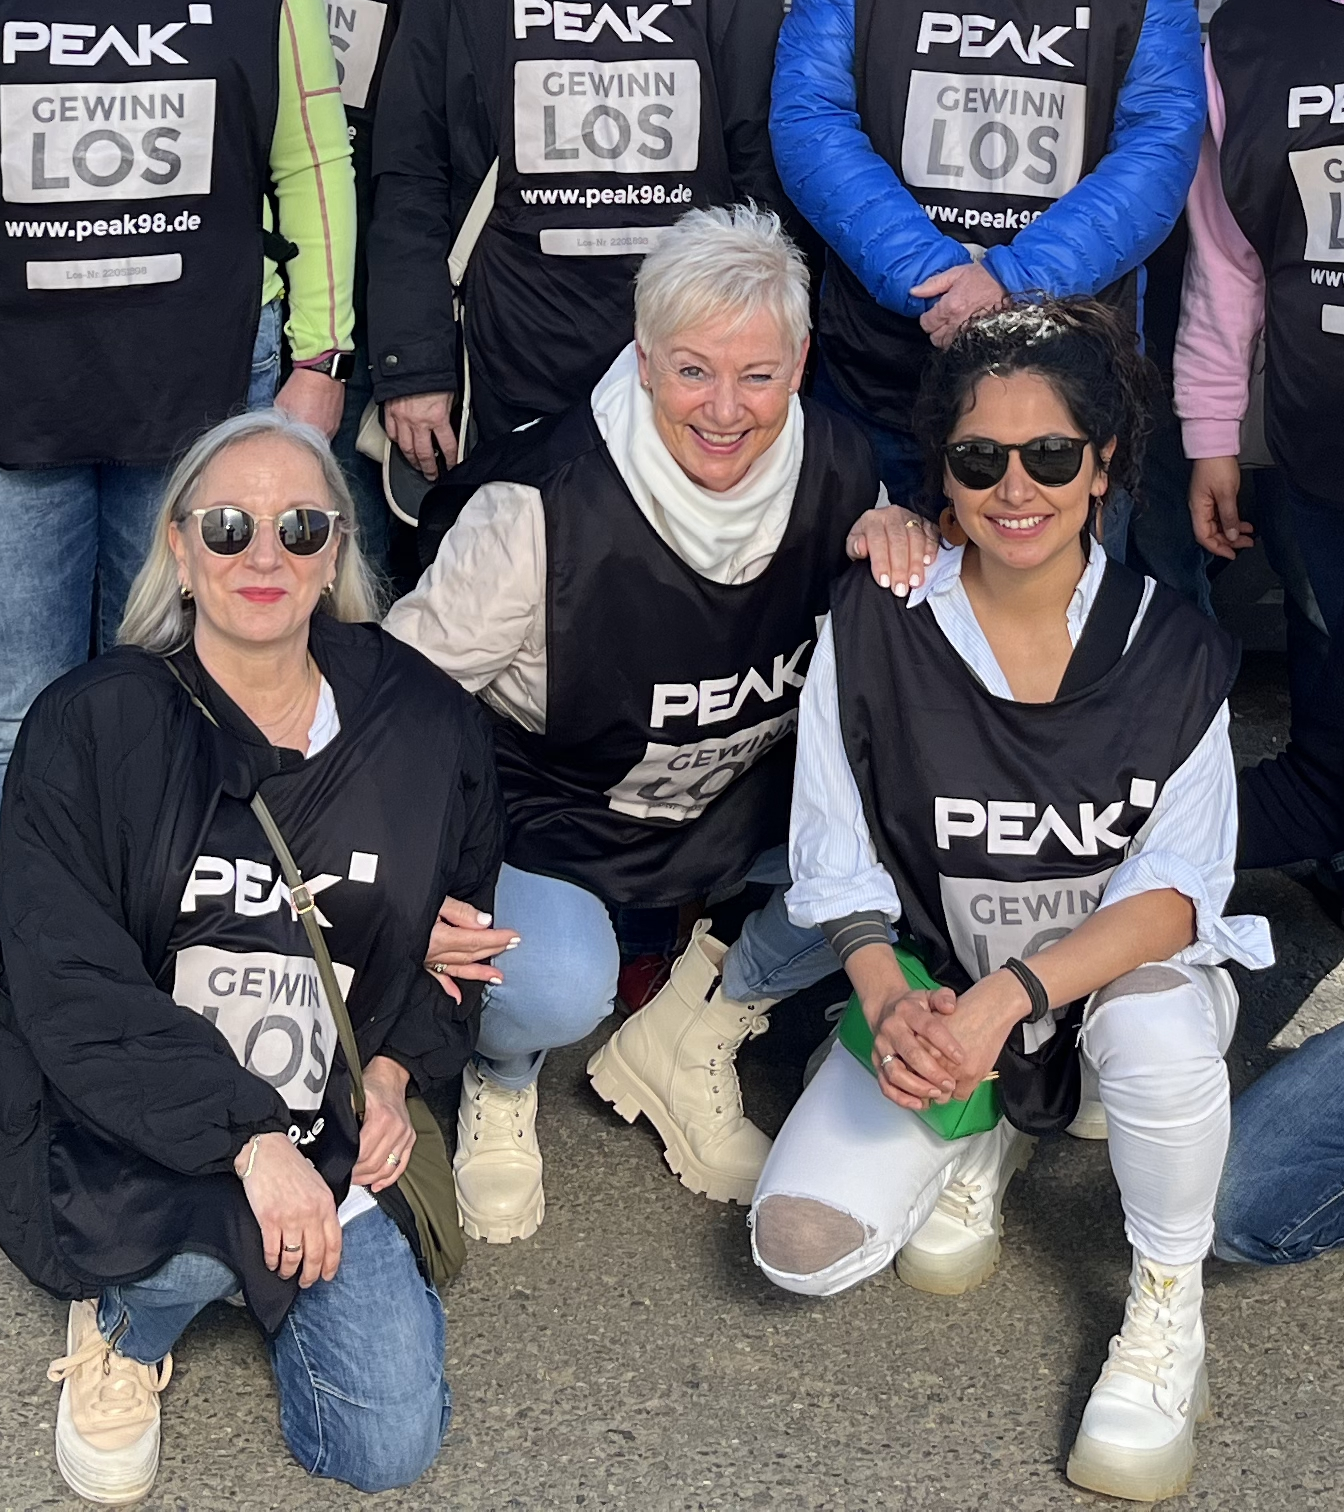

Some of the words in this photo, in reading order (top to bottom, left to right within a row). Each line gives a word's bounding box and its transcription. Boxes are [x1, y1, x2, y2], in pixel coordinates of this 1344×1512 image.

[2, 21, 190, 67] PEAK
[916, 11, 1075, 68] PEAK
[542, 71, 676, 98] GEWINN
[936, 85, 1065, 120] GEWINN
[32, 93, 186, 124] GEWINN
[543, 103, 675, 161] LOS
[926, 118, 1060, 185] LOS
[31, 126, 182, 190] LOS
[520, 183, 693, 209] www.peak98.de
[4, 210, 202, 242] www.peak98.de
[649, 639, 812, 729] PEAK
[934, 796, 1132, 857] PEAK
[969, 881, 1105, 926] GEWIN
[208, 966, 321, 1009] GEWIN
